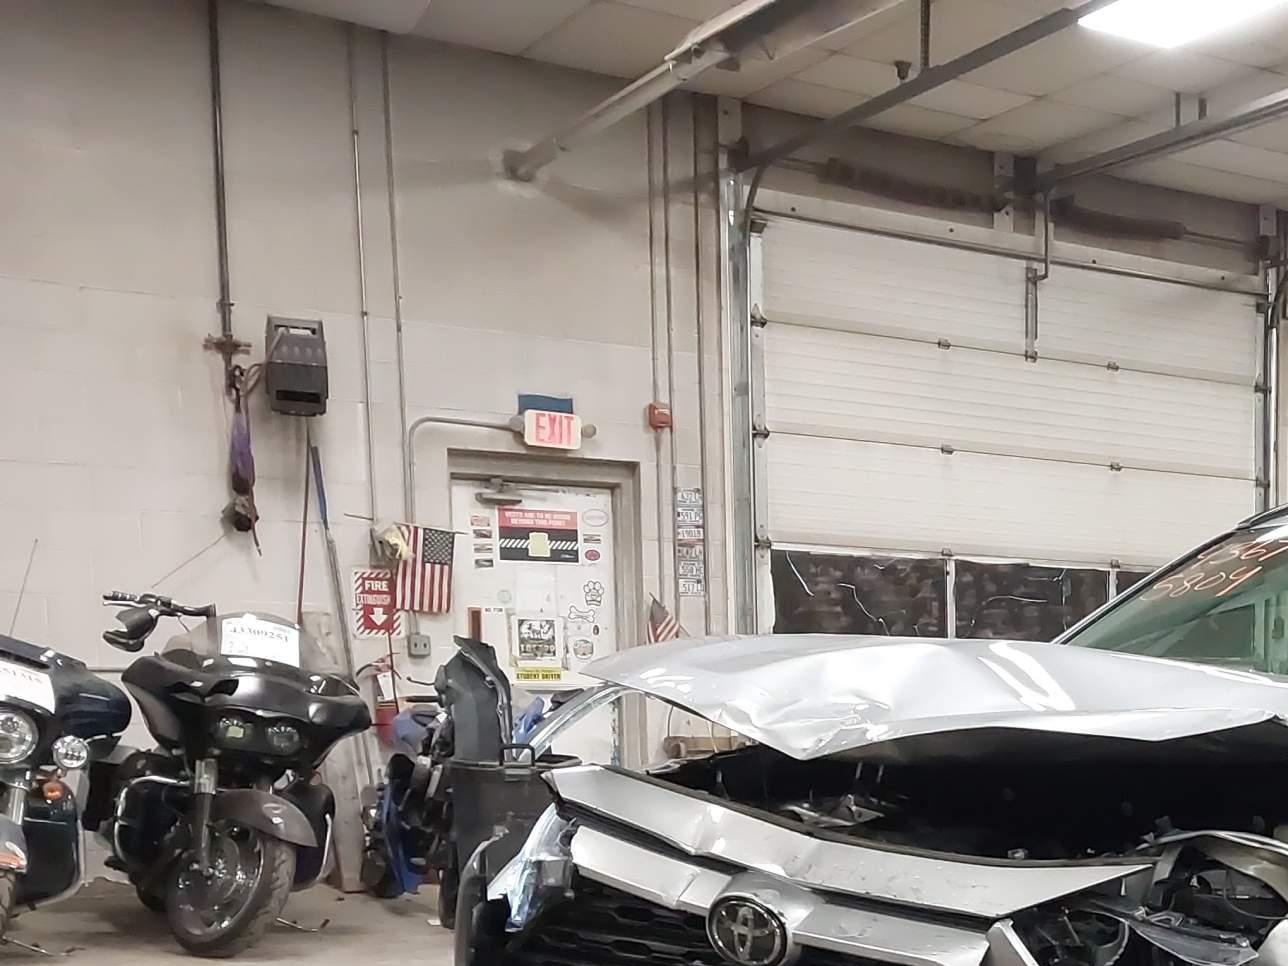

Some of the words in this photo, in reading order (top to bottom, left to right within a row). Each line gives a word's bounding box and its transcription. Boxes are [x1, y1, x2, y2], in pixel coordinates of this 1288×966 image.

[535, 413, 574, 446] EXIT
[364, 580, 389, 591] FIRE
[1140, 566, 1263, 600] 5804
